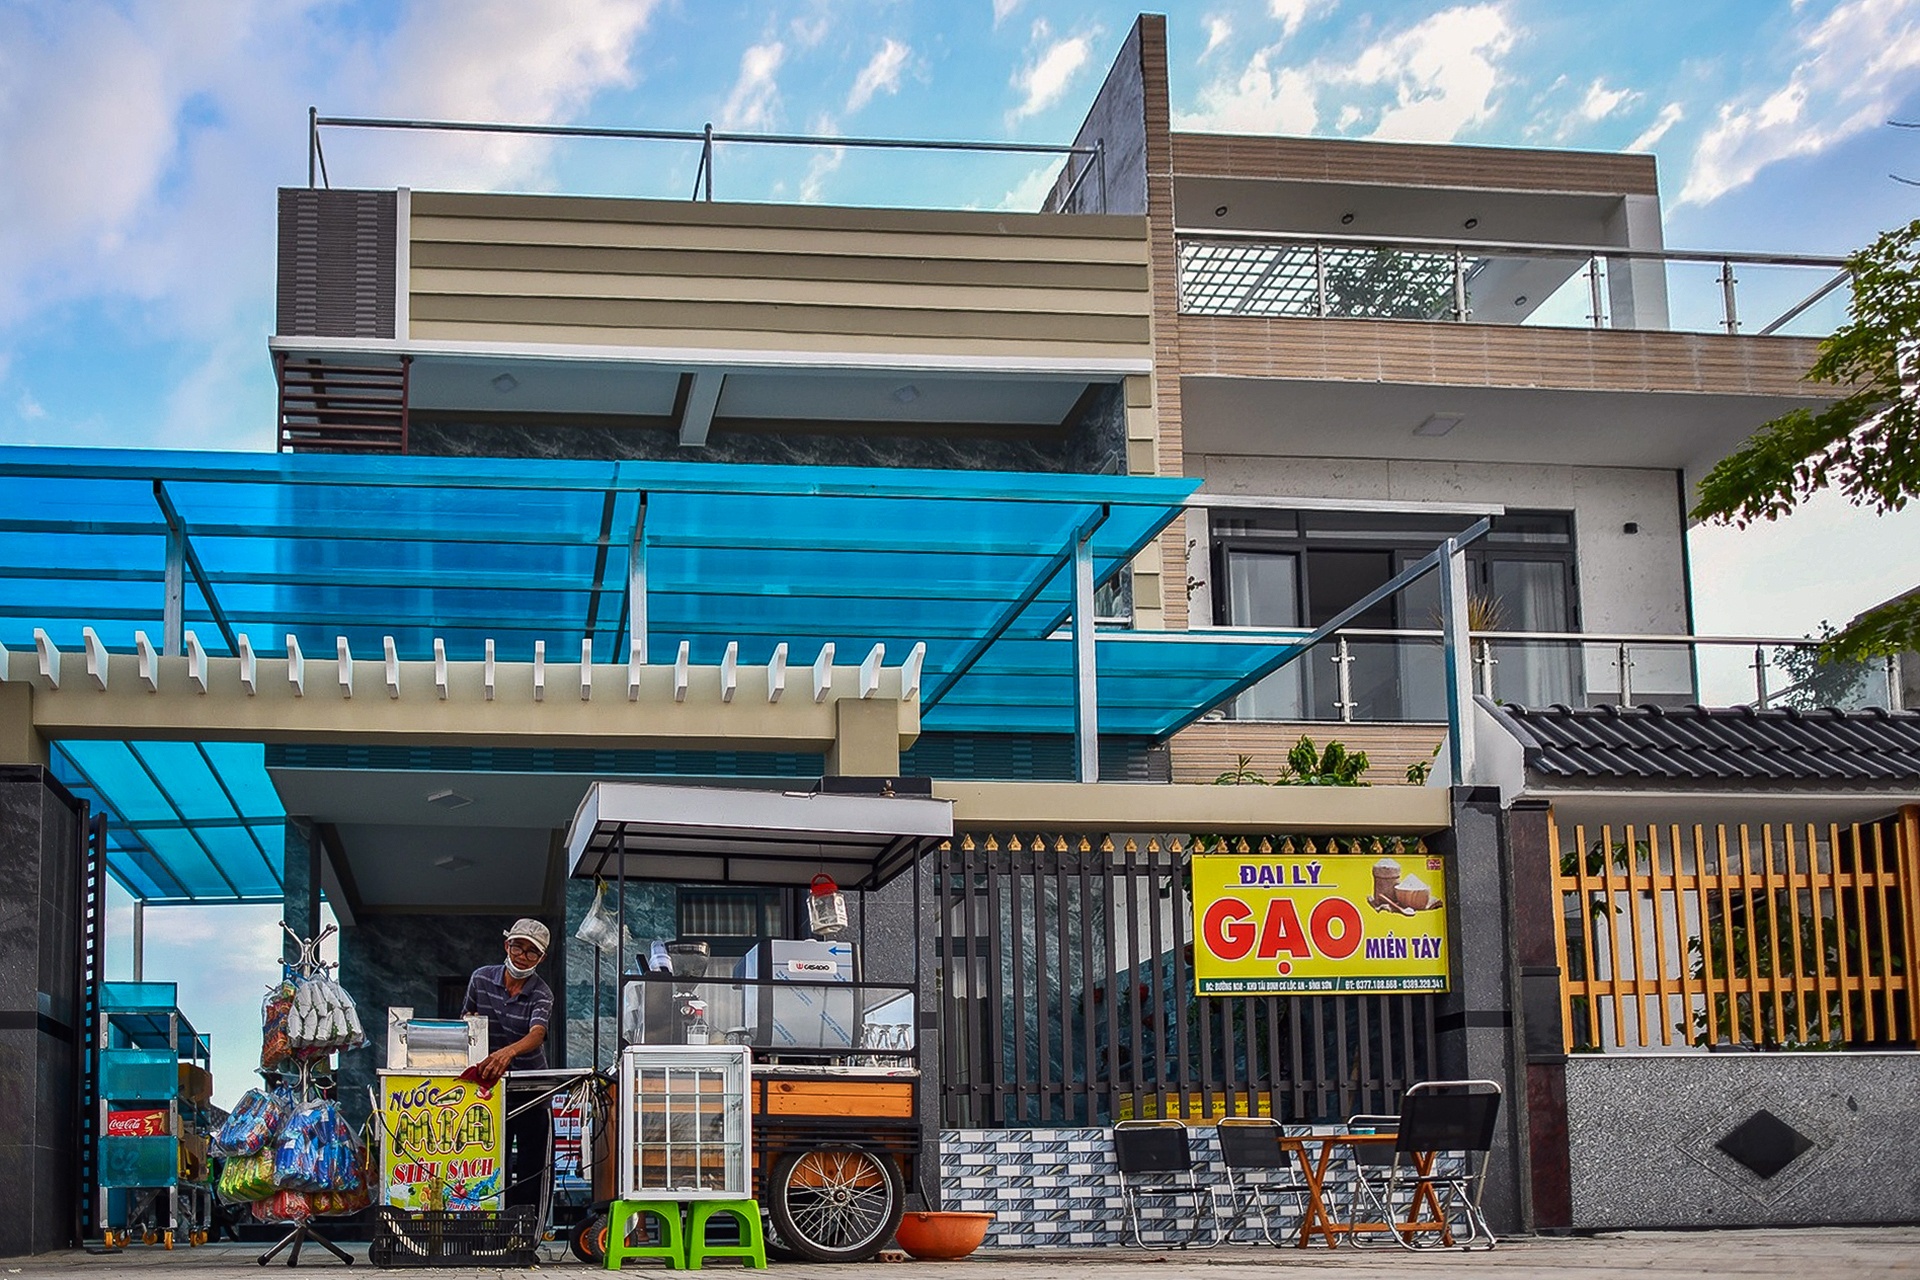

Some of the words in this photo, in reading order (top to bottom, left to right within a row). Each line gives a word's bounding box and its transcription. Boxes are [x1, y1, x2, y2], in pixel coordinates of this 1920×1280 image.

[1240, 865, 1283, 888] ĐẠI
[1293, 861, 1321, 885] LÝ
[1203, 897, 1364, 975] GẠO
[1365, 931, 1406, 959] MIỀN
[1411, 932, 1442, 959] TÂY
[390, 1079, 441, 1111] NƯỚC
[392, 1086, 495, 1156] MÍA
[392, 1158, 442, 1185] SIÊU
[447, 1158, 495, 1185] SẠCH
